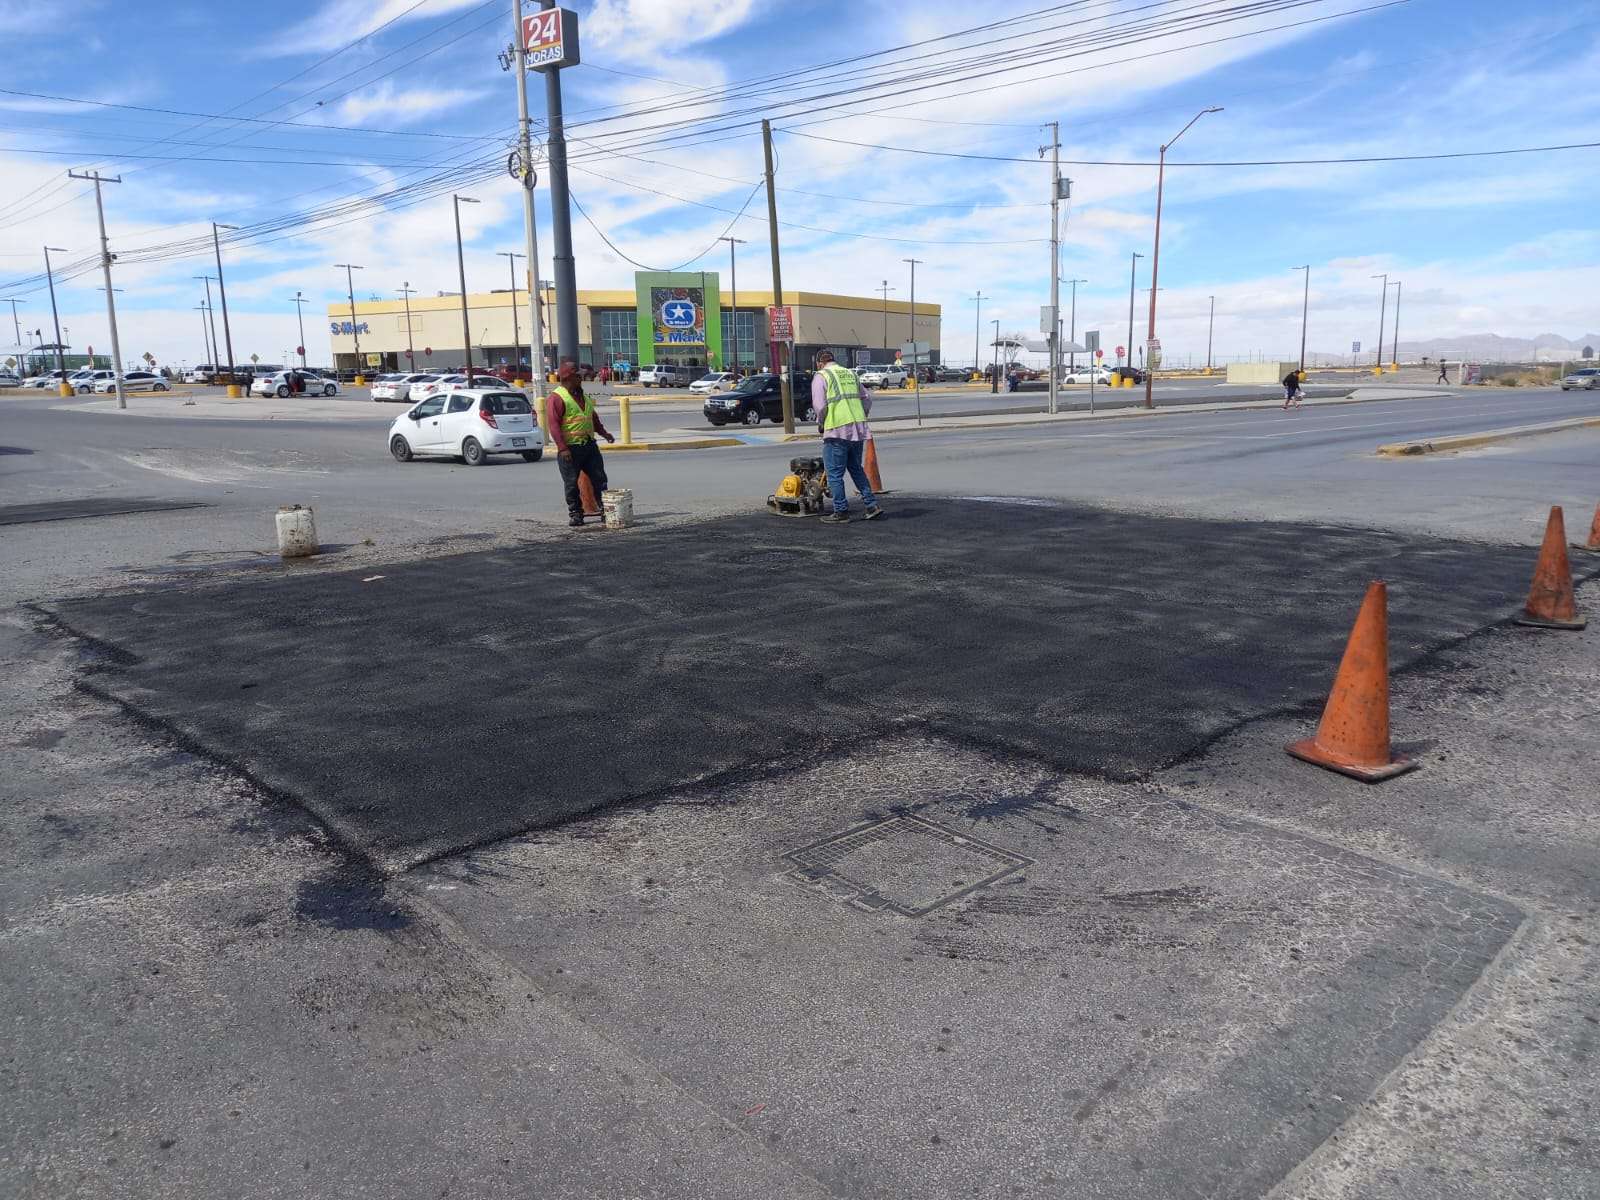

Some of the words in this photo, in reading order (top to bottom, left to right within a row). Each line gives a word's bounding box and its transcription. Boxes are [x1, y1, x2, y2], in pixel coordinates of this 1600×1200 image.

[528, 13, 556, 48] 24
[526, 46, 561, 64] HORAS
[655, 332, 665, 342] S
[669, 332, 705, 343] Mart
